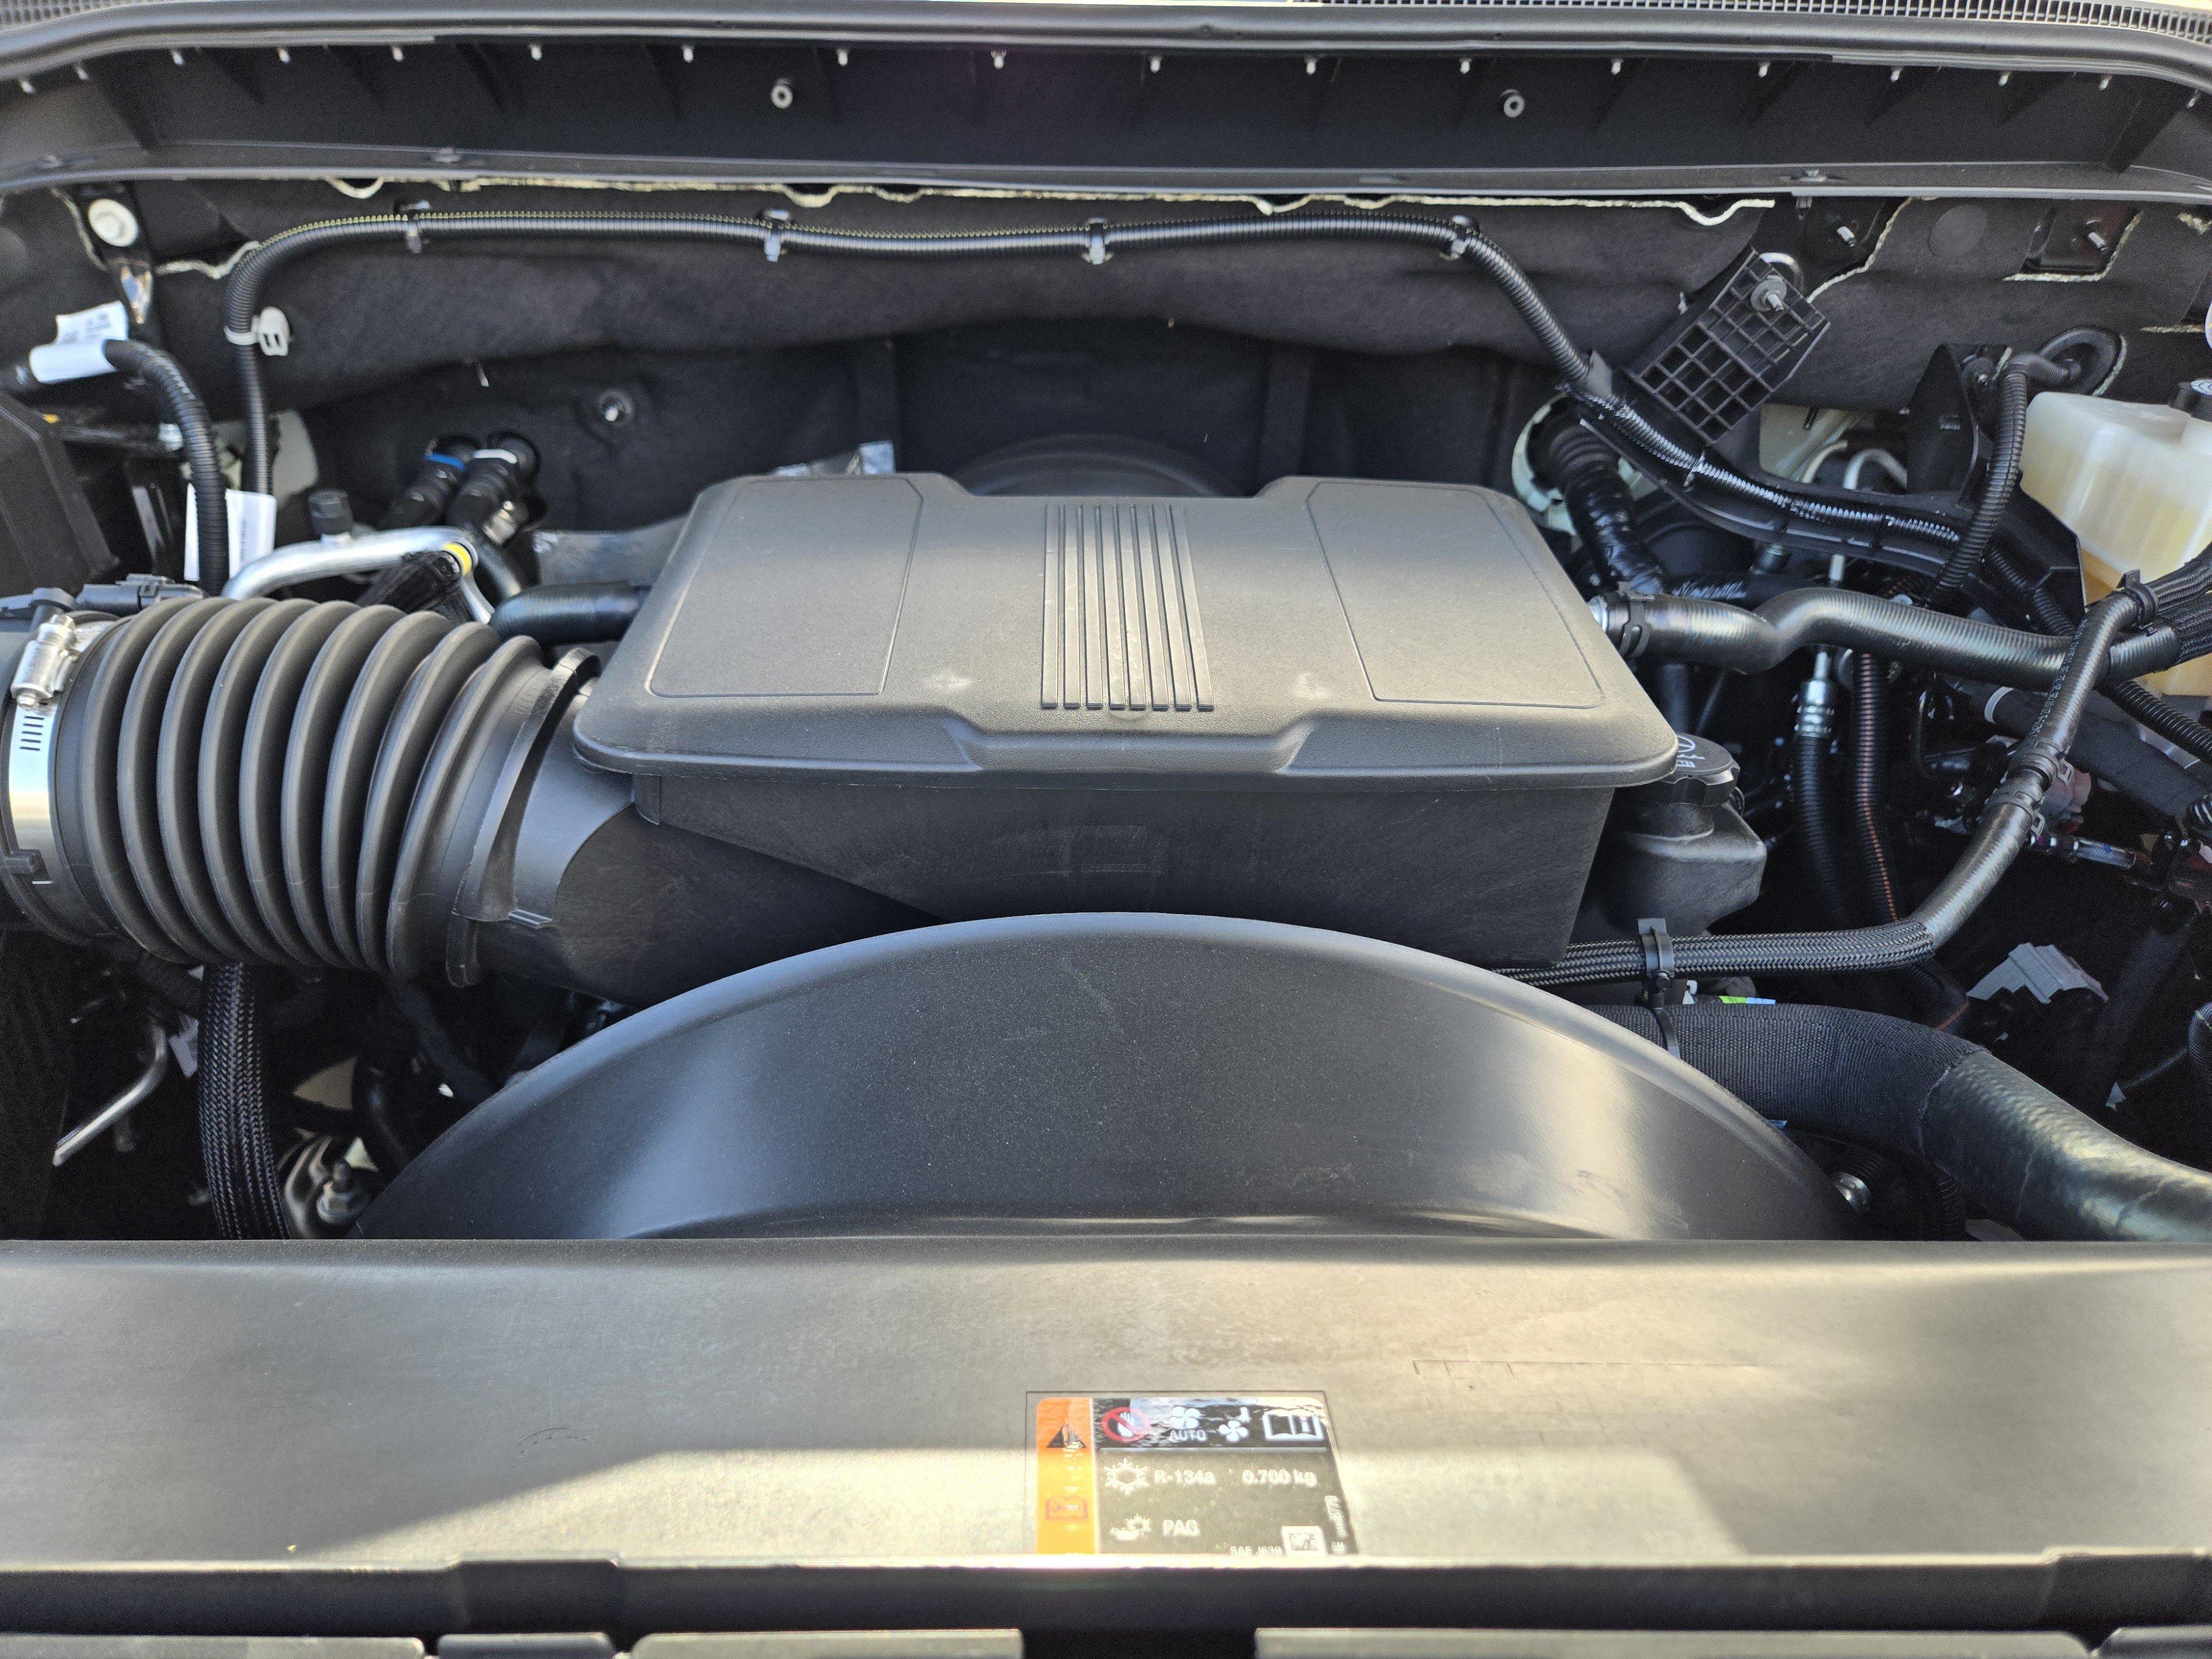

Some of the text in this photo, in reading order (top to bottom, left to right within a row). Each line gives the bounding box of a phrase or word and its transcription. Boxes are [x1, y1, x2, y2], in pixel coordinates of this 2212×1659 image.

[1169, 1430, 1207, 1441] AUTO
[1154, 1468, 1317, 1486] R-134a 0.700 kg
[1163, 1519, 1199, 1536] PAG
[1333, 1541, 1345, 1551] GM
